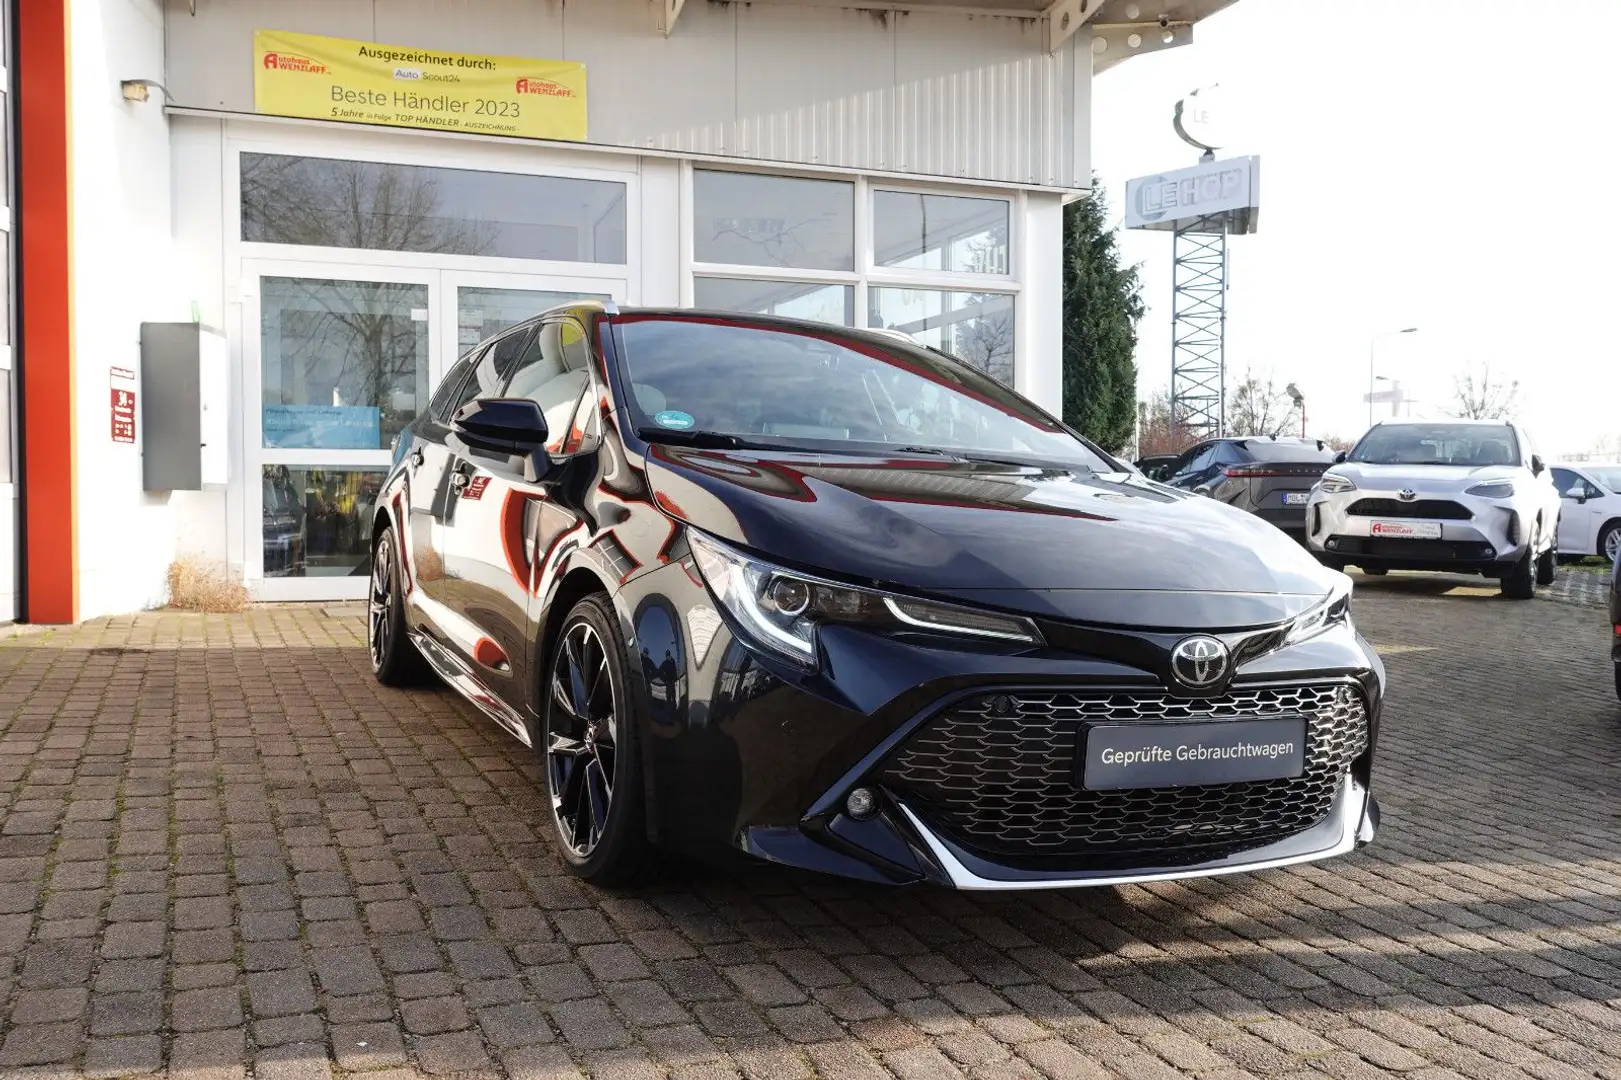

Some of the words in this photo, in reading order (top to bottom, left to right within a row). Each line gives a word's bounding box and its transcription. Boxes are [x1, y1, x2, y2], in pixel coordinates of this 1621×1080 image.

[279, 62, 326, 74] WENZLAFF
[358, 46, 454, 67] Ausgezeichnet
[456, 56, 496, 71] durch:
[395, 69, 419, 80] Auto
[422, 71, 461, 83] Scout24
[331, 85, 387, 107] Beste
[393, 91, 469, 113] Händler
[474, 99, 520, 118] 2023
[331, 107, 338, 117] 5
[339, 109, 364, 119] Jahre
[374, 113, 392, 122] Folge
[395, 113, 414, 123] TOP
[415, 115, 459, 127] HÄNDLER
[1101, 745, 1172, 768] Geprüfte
[1176, 742, 1294, 761] Gebrauchtwagen
